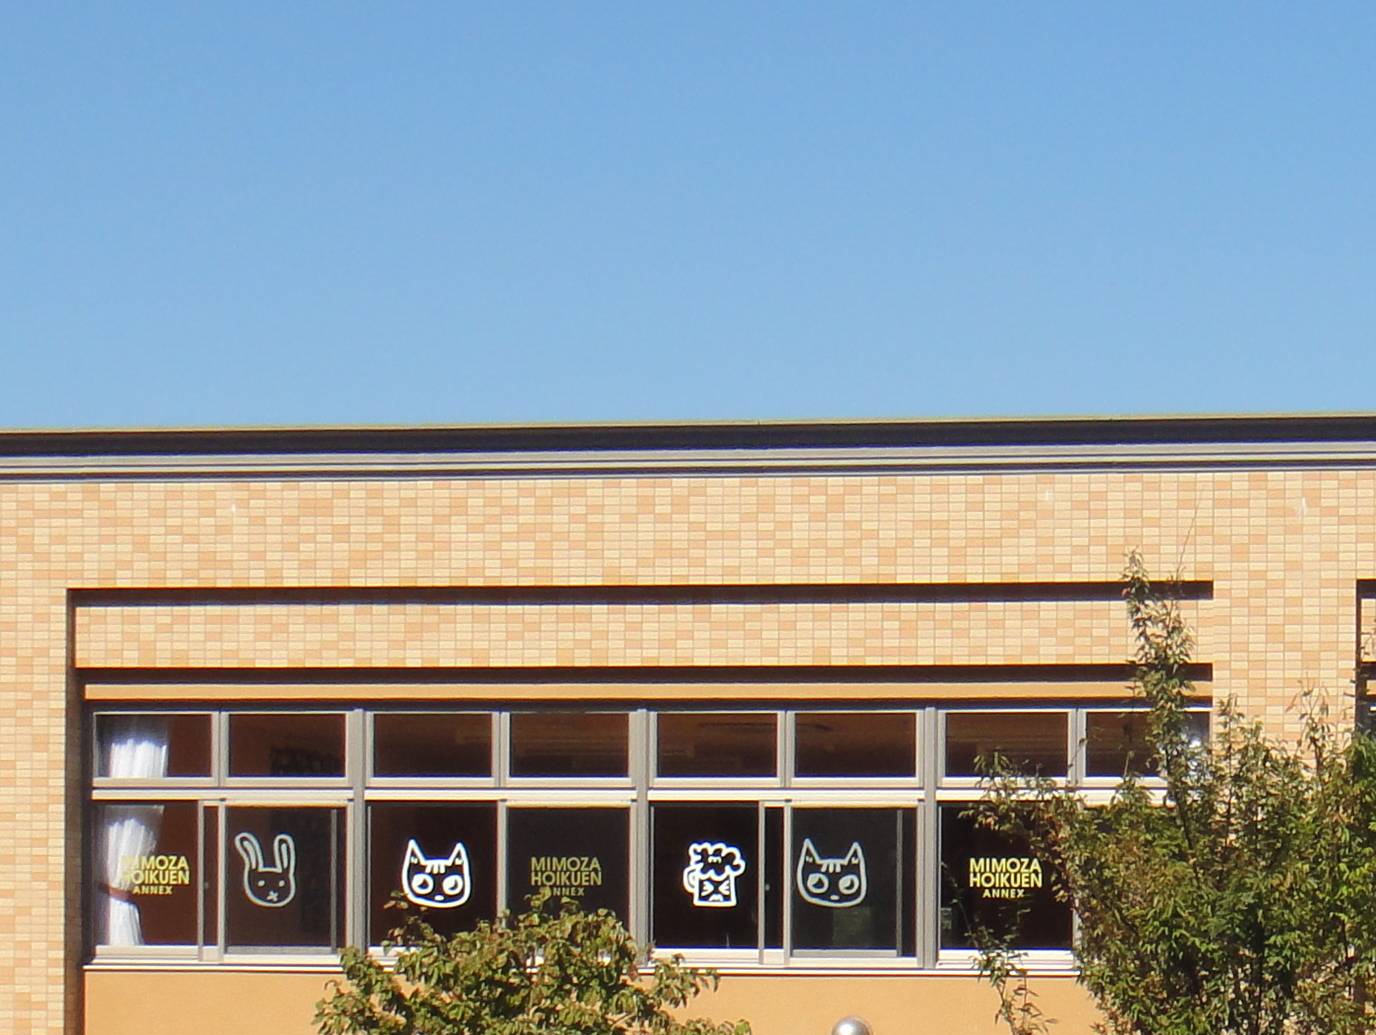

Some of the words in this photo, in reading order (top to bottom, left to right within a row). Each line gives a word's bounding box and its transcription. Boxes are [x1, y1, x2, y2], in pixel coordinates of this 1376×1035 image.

[531, 856, 602, 871] MIMOZA
[969, 857, 1042, 872] MIMOZA
[531, 871, 602, 886] HOIKUEN
[969, 872, 1043, 888] HOIKUEN
[132, 885, 173, 895] ANNEX
[541, 886, 585, 896] NNEX
[982, 888, 1025, 898] ANNEX
